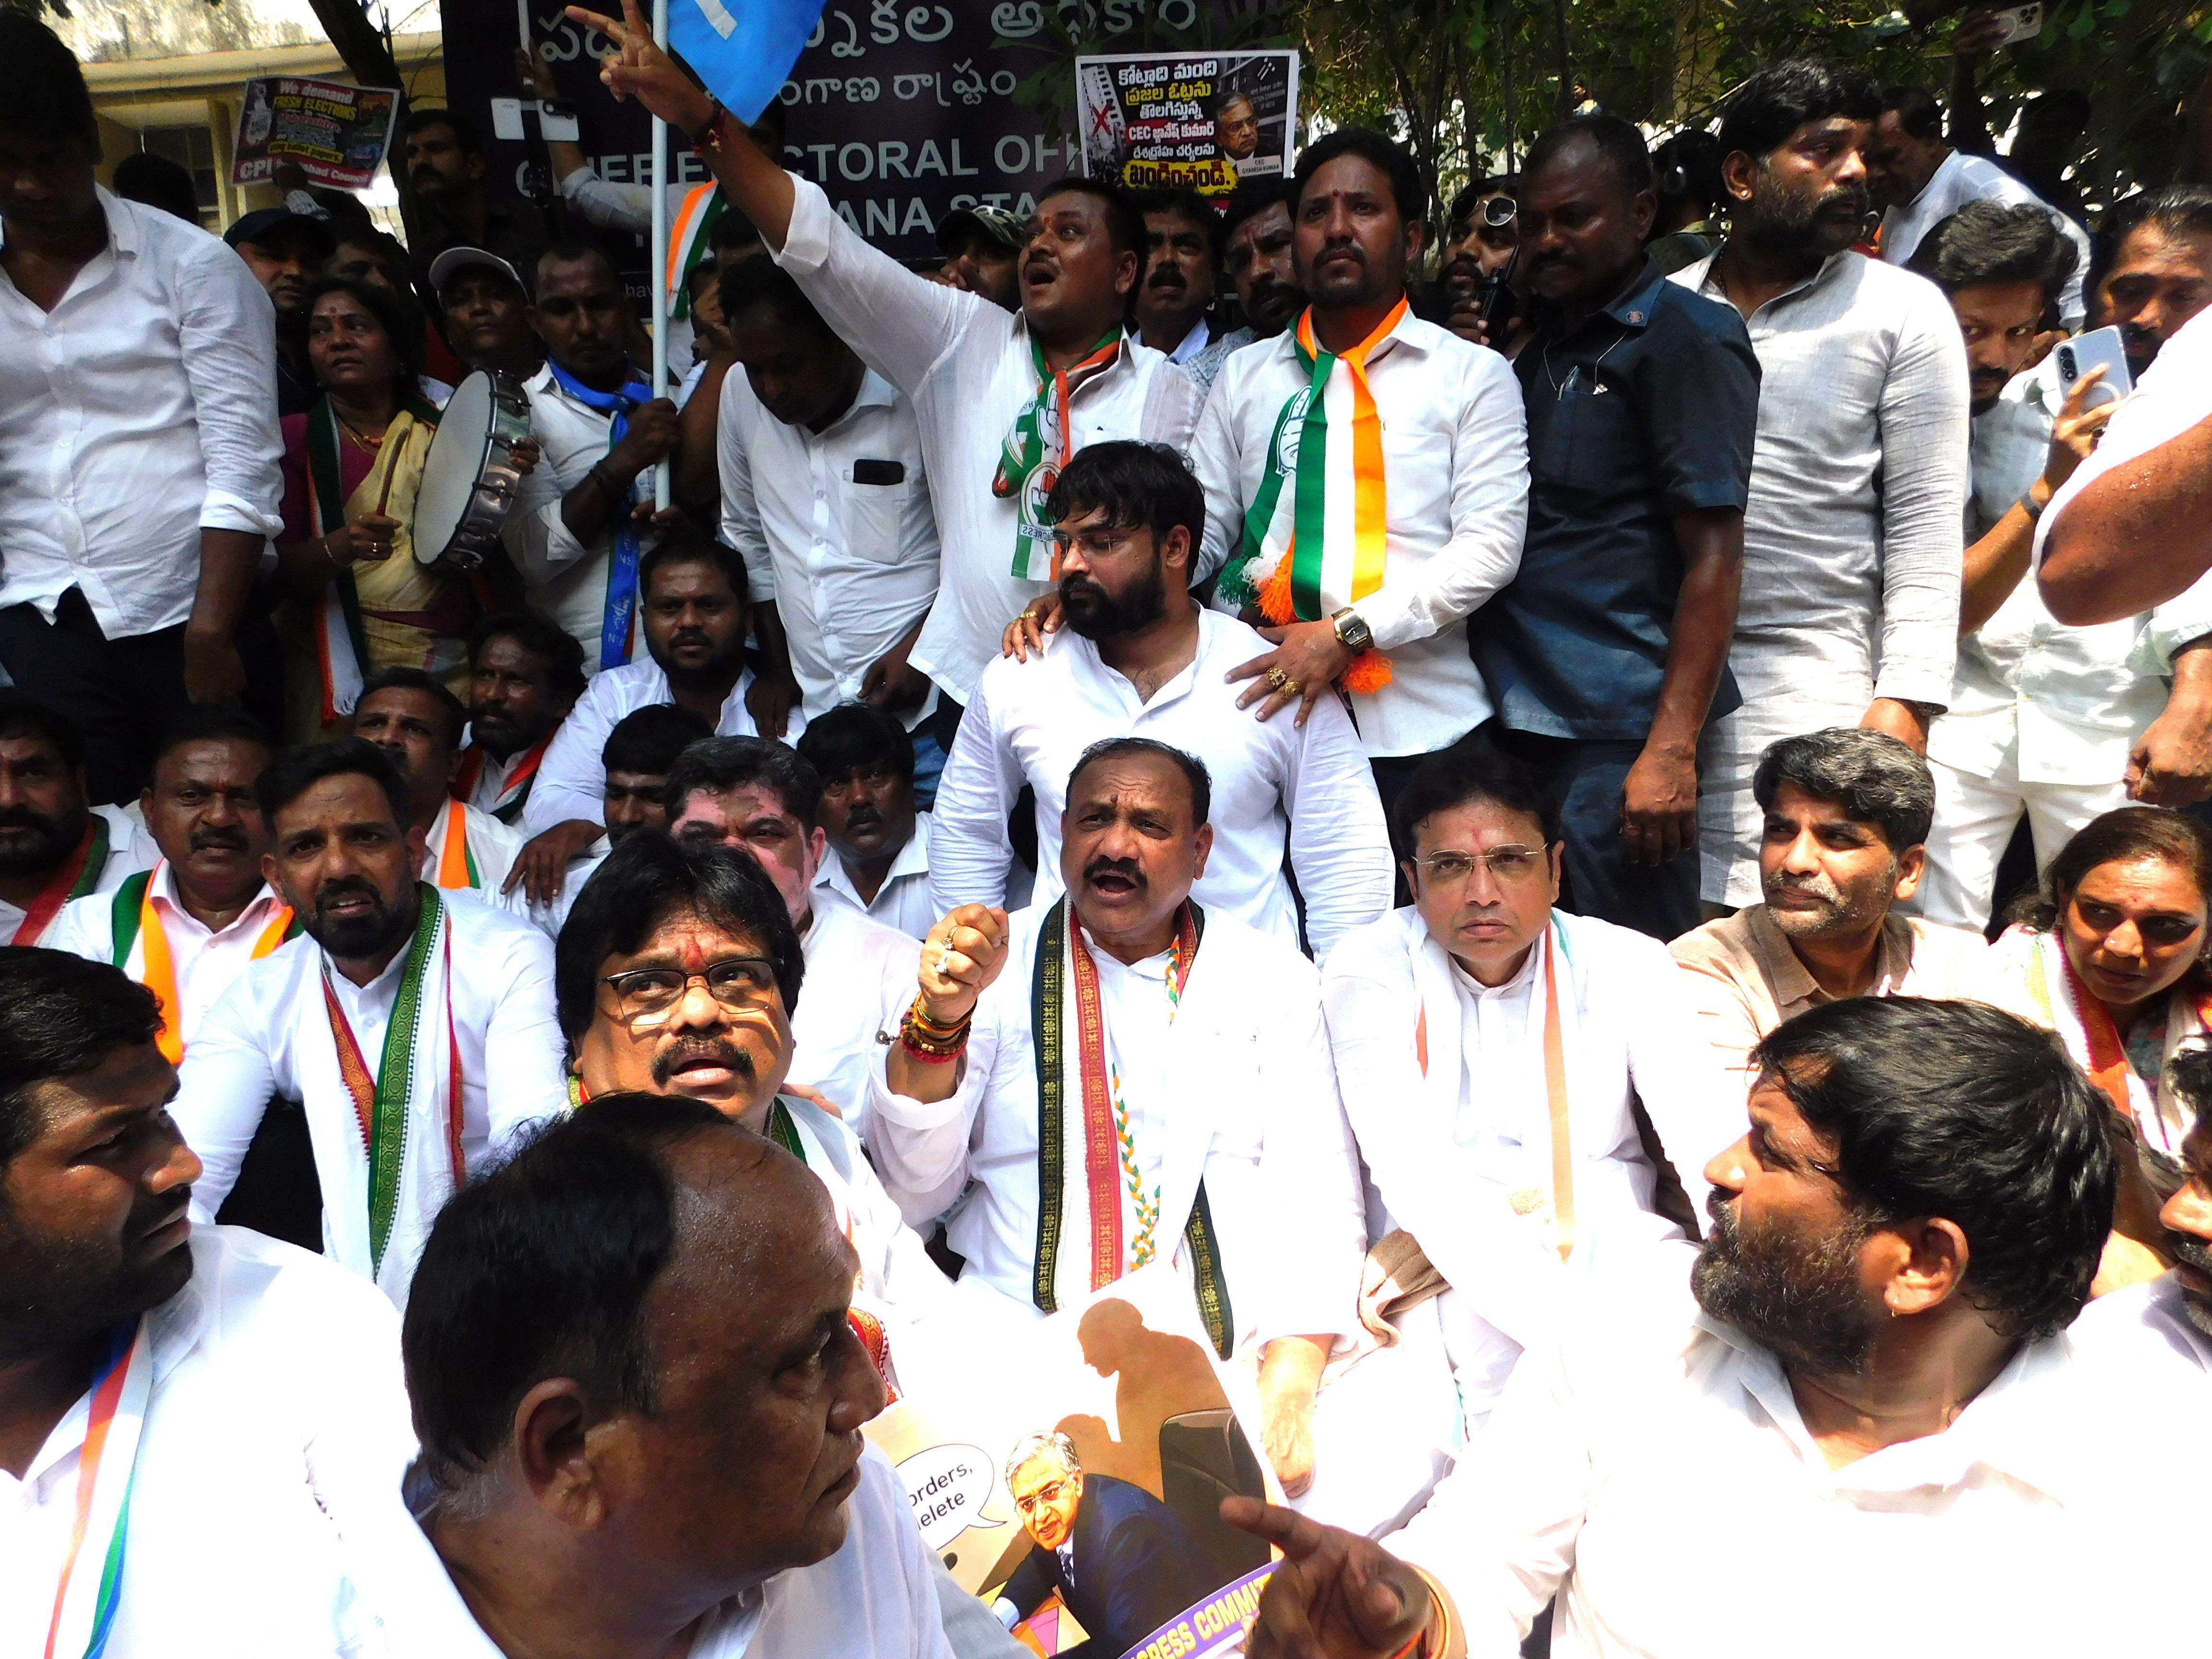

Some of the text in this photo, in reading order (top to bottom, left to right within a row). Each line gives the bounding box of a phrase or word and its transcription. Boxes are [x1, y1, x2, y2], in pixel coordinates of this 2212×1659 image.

[1174, 60, 1217, 80] మంది
[1125, 87, 1164, 106] ప్రజల
[1129, 126, 1151, 141] CEC
[240, 157, 273, 180] CPI
[916, 1493, 965, 1530] elete
